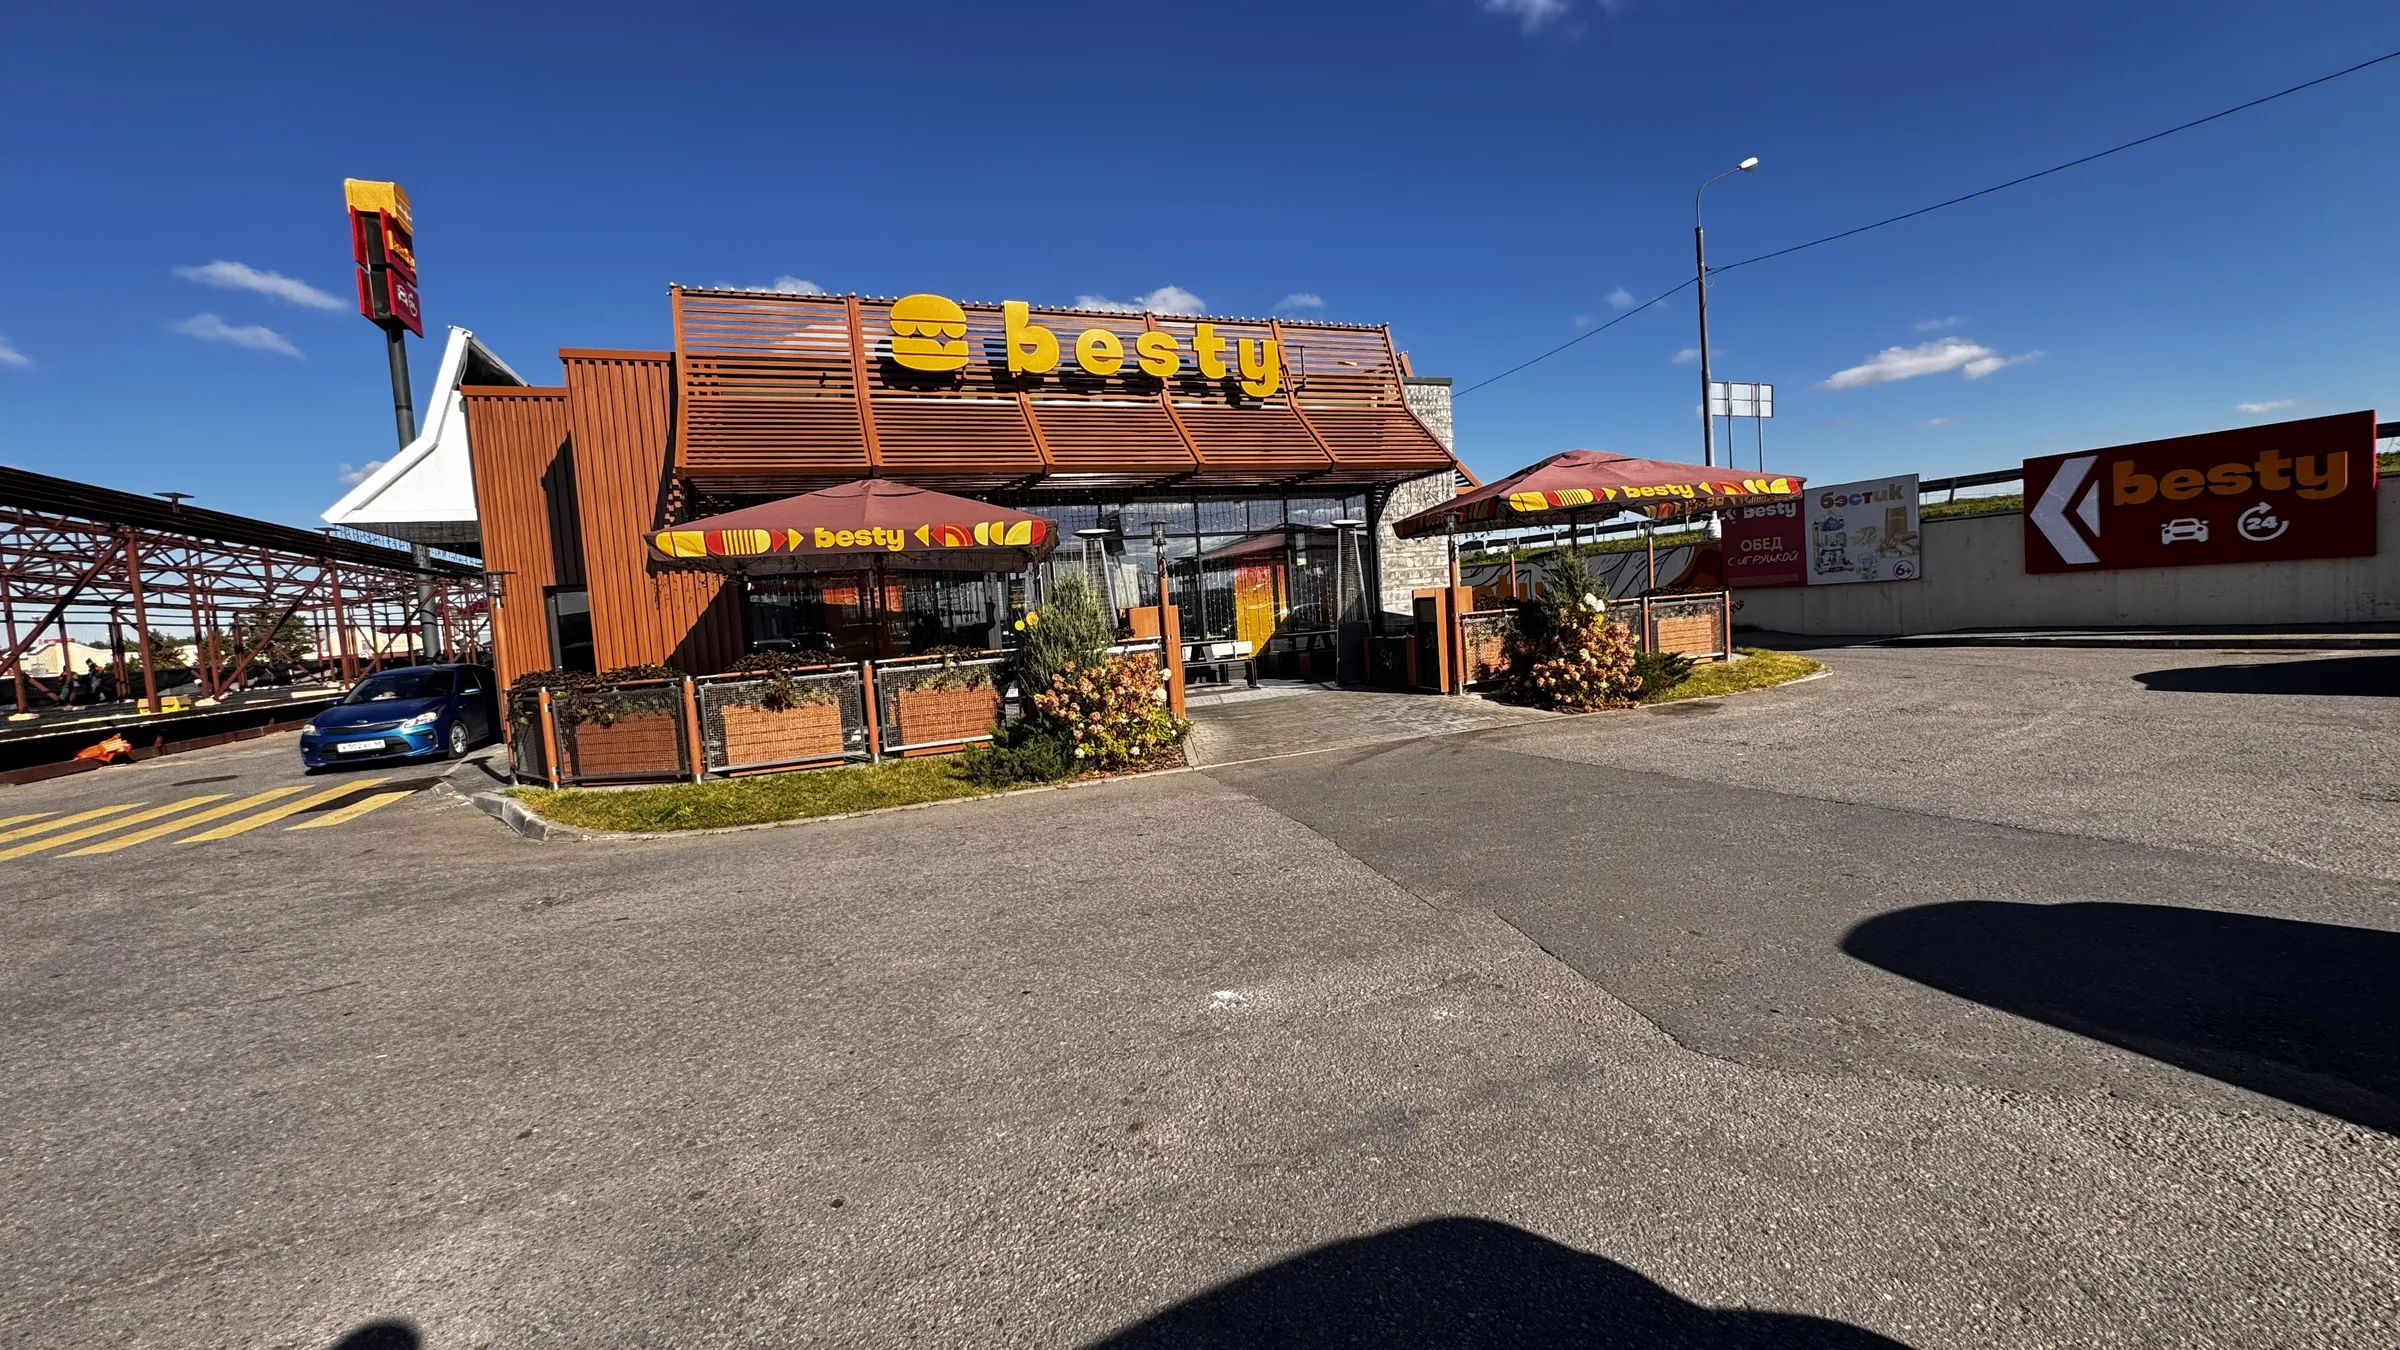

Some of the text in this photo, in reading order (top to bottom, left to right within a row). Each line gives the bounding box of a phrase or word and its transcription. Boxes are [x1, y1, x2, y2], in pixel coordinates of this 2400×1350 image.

[1003, 300, 1280, 397] besty
[2113, 450, 2348, 506] besty
[1621, 484, 1695, 498] besty
[1743, 502, 1797, 518] besty
[2245, 516, 2279, 530] 24
[814, 527, 905, 551] besty
[1740, 536, 1783, 552] ОБЕД
[1895, 564, 1912, 576] 6+
